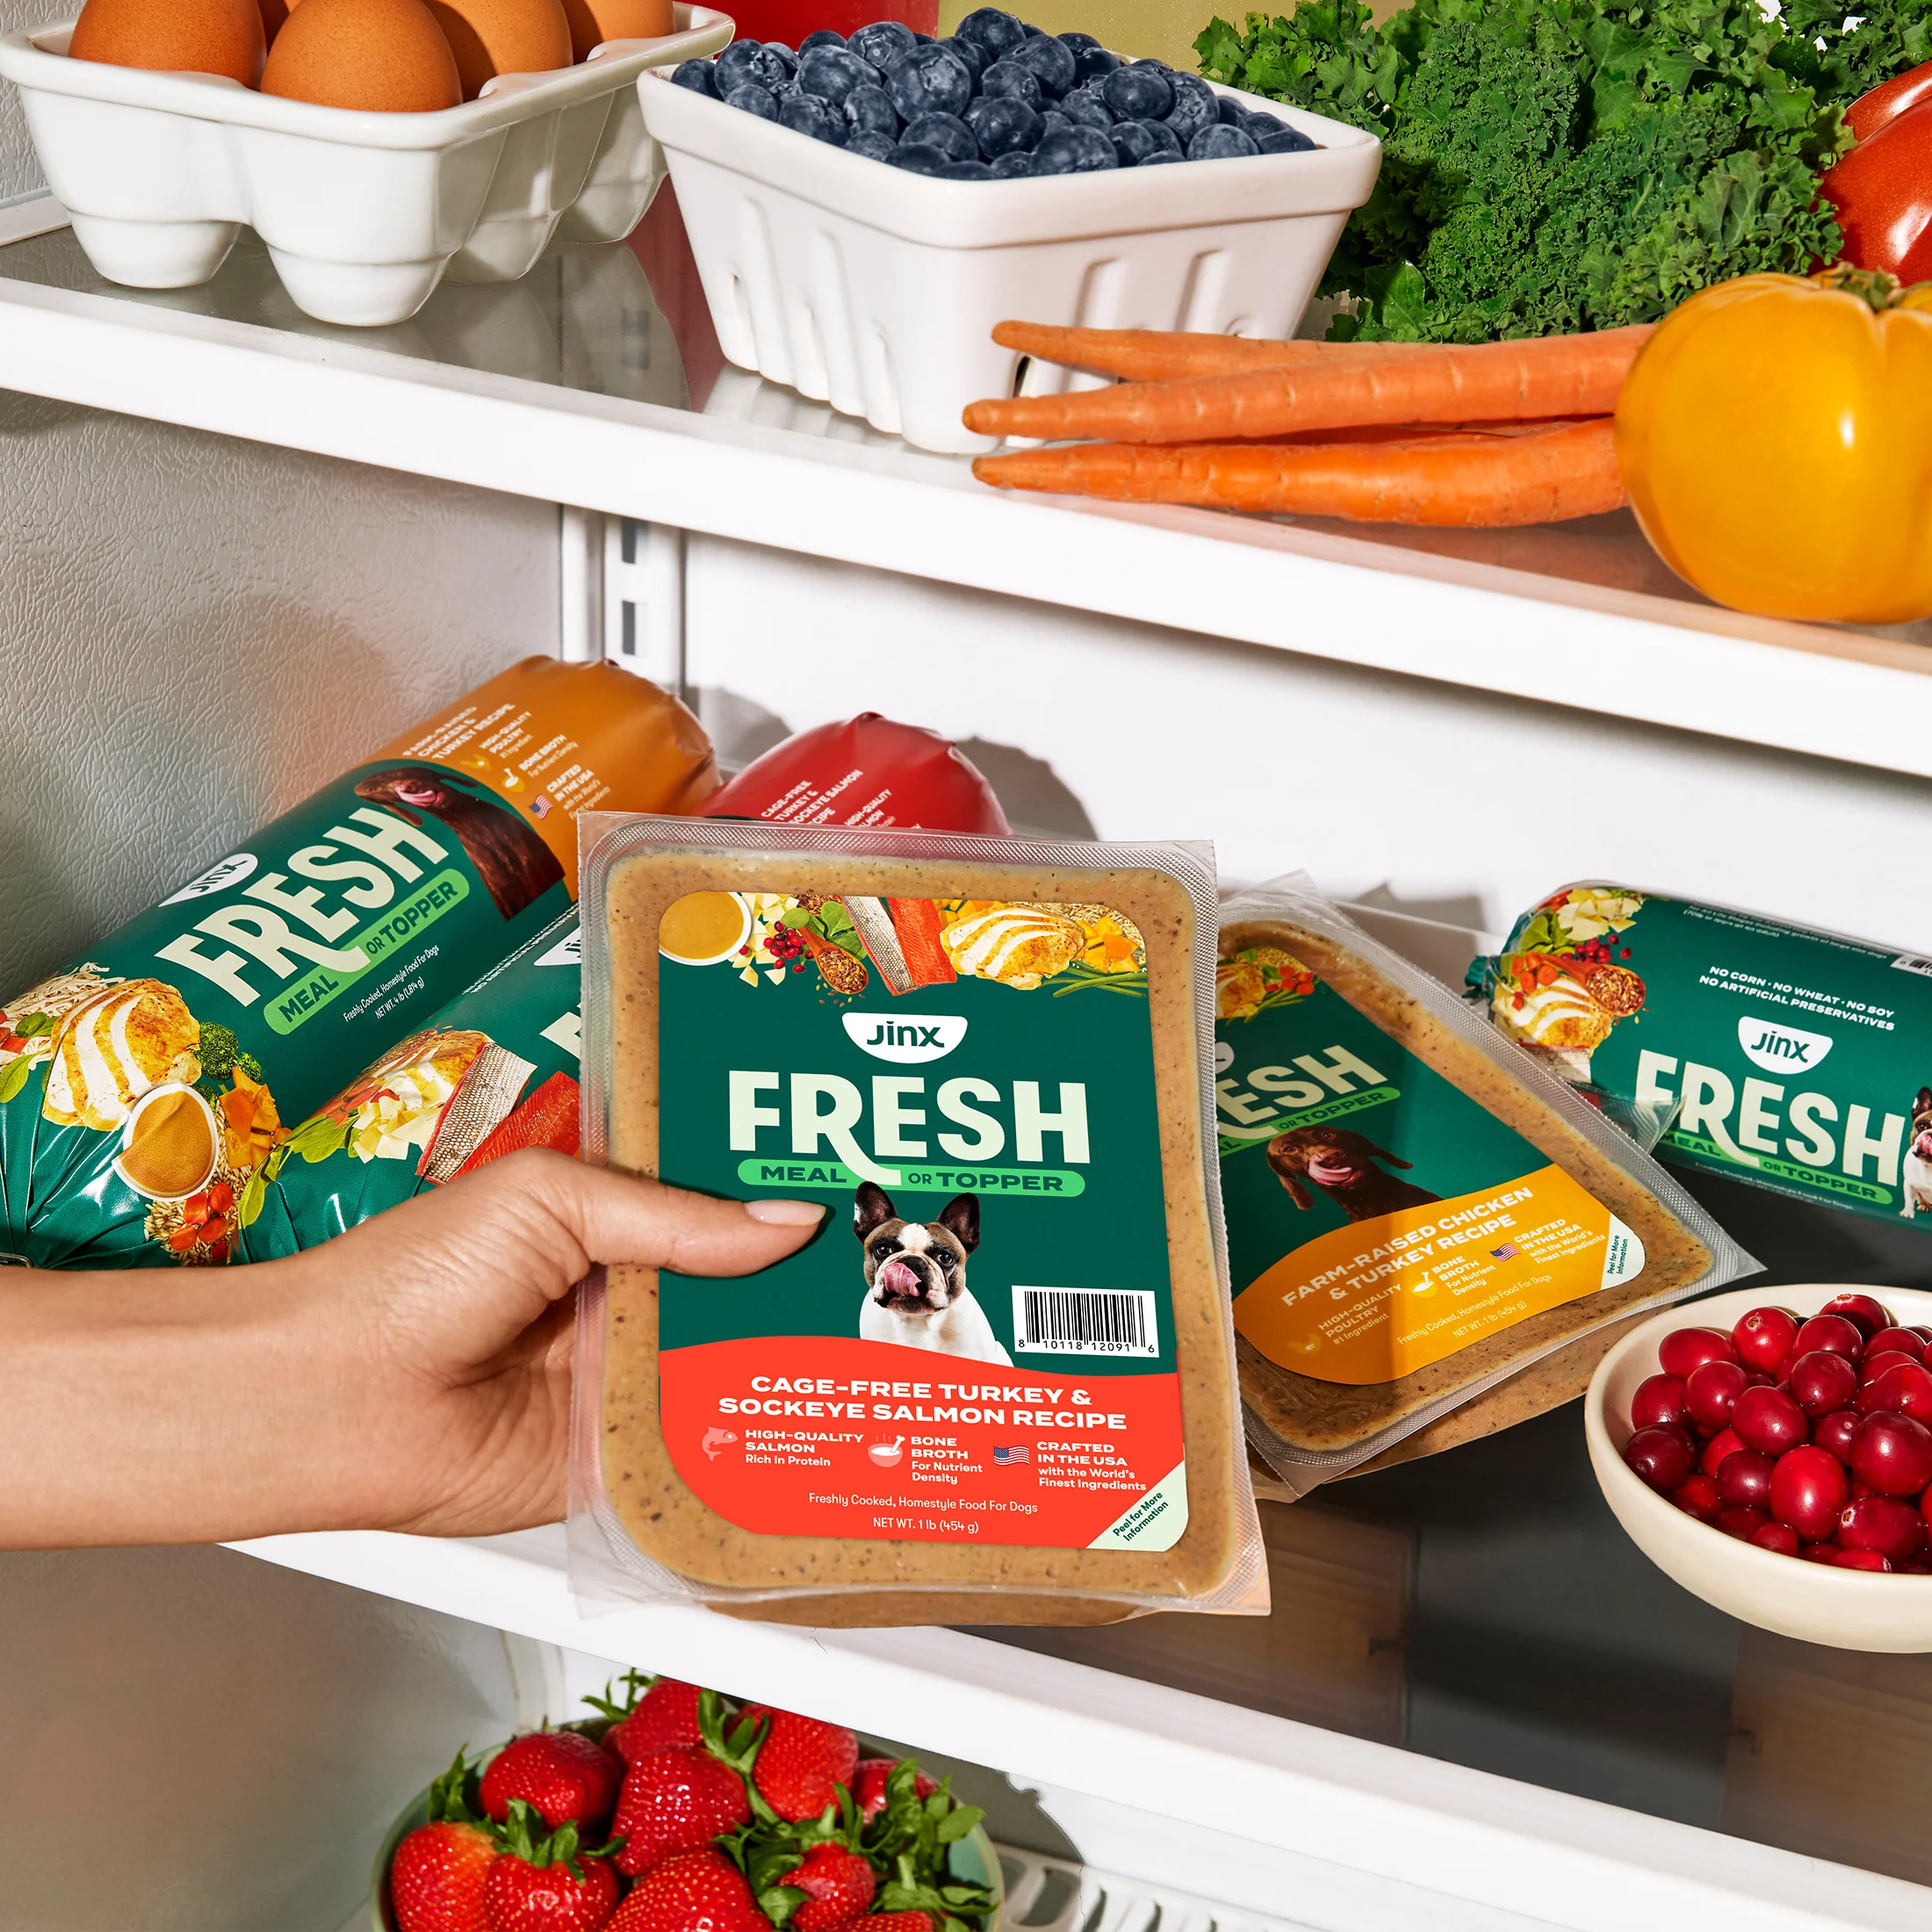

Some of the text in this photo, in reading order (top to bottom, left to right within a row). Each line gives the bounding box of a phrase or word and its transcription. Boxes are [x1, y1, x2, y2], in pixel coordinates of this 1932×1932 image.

[417, 724, 467, 756] CHICKEN
[431, 703, 515, 759] TURKEY RECIPE
[479, 710, 532, 749] HIGH-QUALITY
[489, 727, 524, 753] POULTRY
[519, 733, 567, 771] BONE BROTH
[527, 767, 539, 778] For
[536, 753, 559, 771] Nutrient
[546, 764, 581, 793] CRAFTED
[554, 769, 595, 802] IN THE USA
[825, 769, 863, 797] SALMON
[563, 798, 576, 811] with
[573, 792, 584, 803] the
[761, 780, 812, 818] CAGE-FREE
[774, 795, 811, 820] TURKEY
[844, 789, 892, 826] HIGH-QUALITY
[808, 807, 835, 825] CIPE
[154, 807, 449, 1007] FRESH
[278, 881, 458, 1022] MEAL OR TOPPER
[342, 945, 439, 1022] Freshly Cooked, Homestyle Food For Dogs
[375, 1005, 386, 1019] NET
[385, 999, 395, 1012] WT.
[398, 992, 405, 1002] lb
[403, 982, 419, 998] (1,814
[417, 977, 425, 989] g)
[1710, 966, 1895, 1019] NO CORN NO WHEAT NO SOY
[1698, 976, 1895, 1031] NO ARTIFICIAL PRESERVATIVES
[1215, 1044, 1388, 1140] ESH
[1279, 1092, 1387, 1130] OR TOPPER
[1635, 1049, 1906, 1186] FRESH
[729, 1070, 1091, 1186] FRESH
[760, 1164, 1064, 1192] MEAL OR TOPPER
[1763, 1161, 1782, 1172] OR
[1783, 1166, 1878, 1200] TOPPER
[1281, 1186, 1534, 1307] FARM-RAISED CHICKEN
[1514, 1219, 1566, 1244] CRAFTED
[1520, 1223, 1582, 1251] IN THE USA
[1329, 1214, 1517, 1301] & TURKEY RECIPE
[1529, 1247, 1547, 1258] with
[1547, 1241, 1561, 1252] the
[1535, 1234, 1606, 1264] Finest Ingredients
[1616, 1238, 1628, 1275] Information
[1431, 1256, 1466, 1274] BONE
[1438, 1260, 1480, 1281] BROTH
[1446, 1265, 1496, 1289] For Nutrient
[1453, 1278, 1488, 1296] Density
[1318, 1283, 1402, 1330] HIGH-QUALITY
[1325, 1306, 1380, 1337] POULTRY
[1396, 1274, 1553, 1345] Freshly Cooked, Homestyle Food For Dogs
[1453, 1300, 1527, 1338] NET WT. 1 lb (454 g)
[1333, 1313, 1389, 1345] #1 Ingredient
[1018, 1338, 1156, 1354] 8 10118 12091 6
[751, 1376, 1092, 1406] CAGE-FREE TURKEY &
[718, 1397, 1128, 1430] SOCKEYE SALMON RECIPE
[745, 1429, 864, 1444] HIGH-QUALITY
[745, 1441, 816, 1453] SALMON
[911, 1436, 957, 1447] BONE
[1036, 1441, 1115, 1453] CRAFTED
[746, 1453, 831, 1467] Rich in Protein
[911, 1449, 969, 1460] BROTH
[911, 1460, 983, 1473] For Nutrient
[1037, 1453, 1128, 1467] IN THE USA
[912, 1472, 958, 1485] Density
[1038, 1467, 1135, 1479] with the World's
[1039, 1477, 1147, 1491] Finest Ingredients
[809, 1492, 1038, 1515] Freshly Cooked, Homestyle Food For Dogs
[1112, 1492, 1163, 1537] Peel for More
[873, 1517, 979, 1534] NET WT. 1 lb (454 g)
[1122, 1502, 1169, 1541] Information
